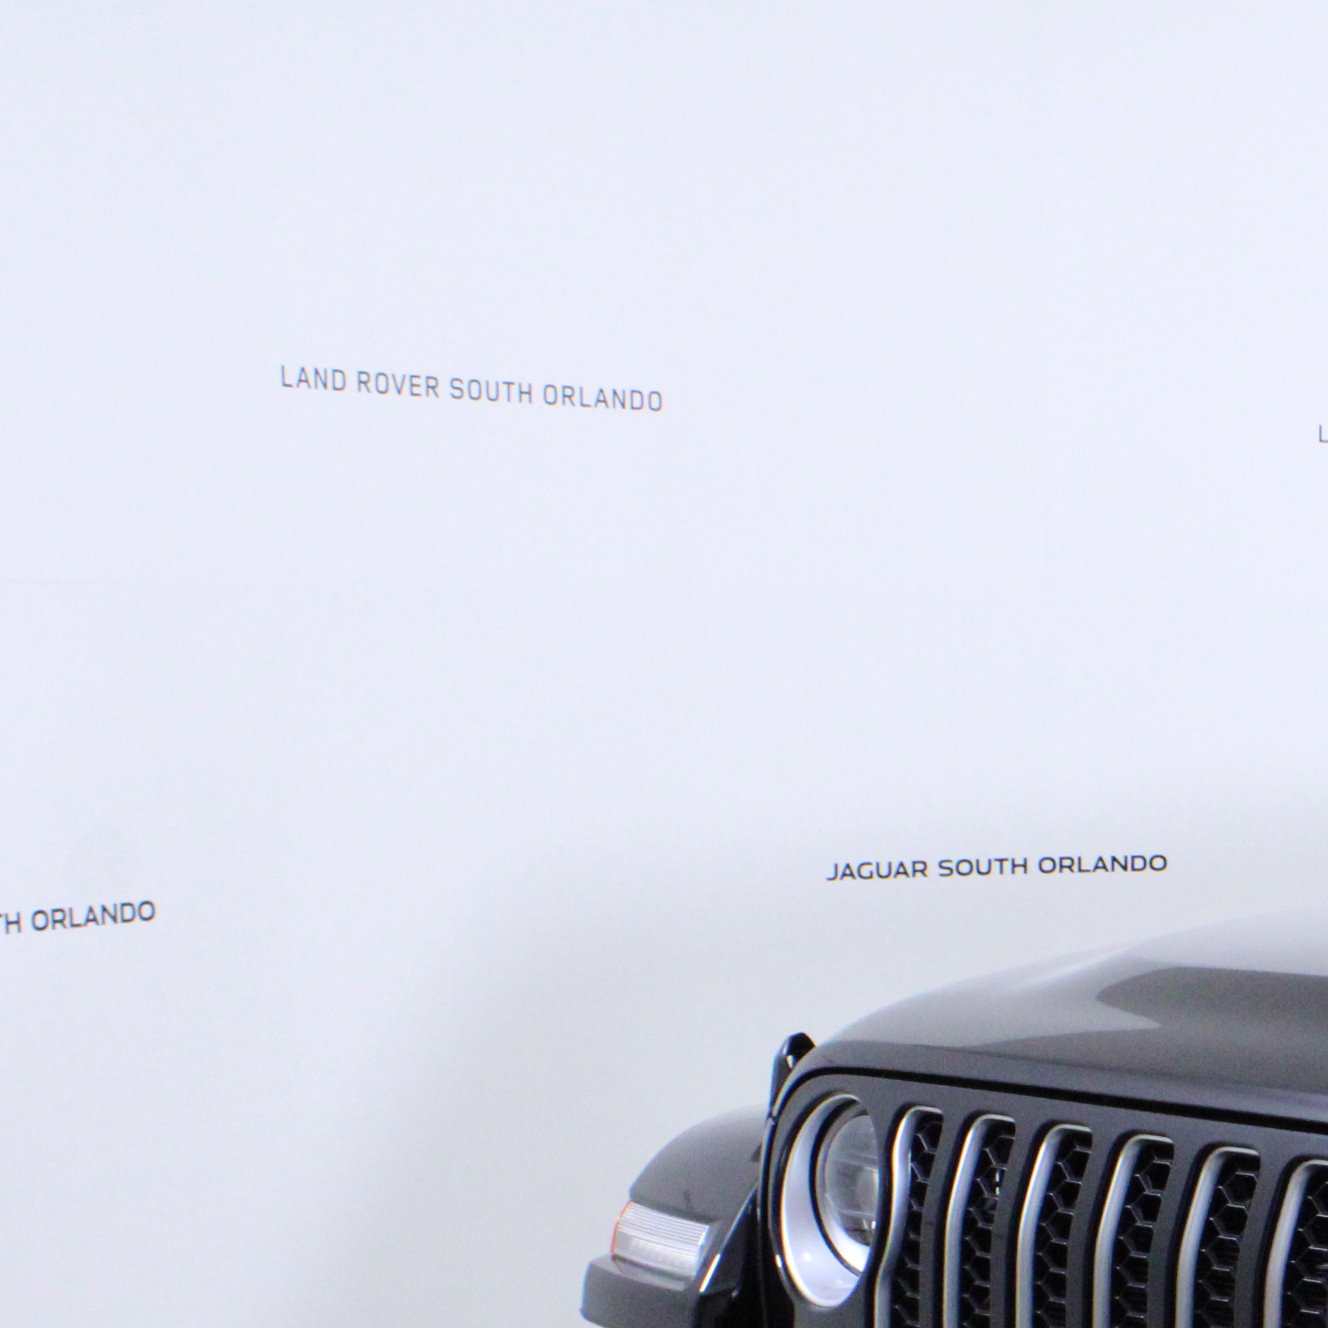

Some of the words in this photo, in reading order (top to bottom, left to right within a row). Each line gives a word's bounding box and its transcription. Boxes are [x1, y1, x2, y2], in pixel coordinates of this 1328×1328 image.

[280, 364, 347, 392] LAND
[357, 370, 439, 398] ROVER
[449, 377, 533, 404] SOUTH
[543, 384, 663, 413] ORLANDO
[826, 861, 928, 882] JAGUAR
[938, 858, 1028, 878] SOUTH
[1038, 854, 1168, 875] ORLANDO
[31, 900, 156, 932] ORLANDO
